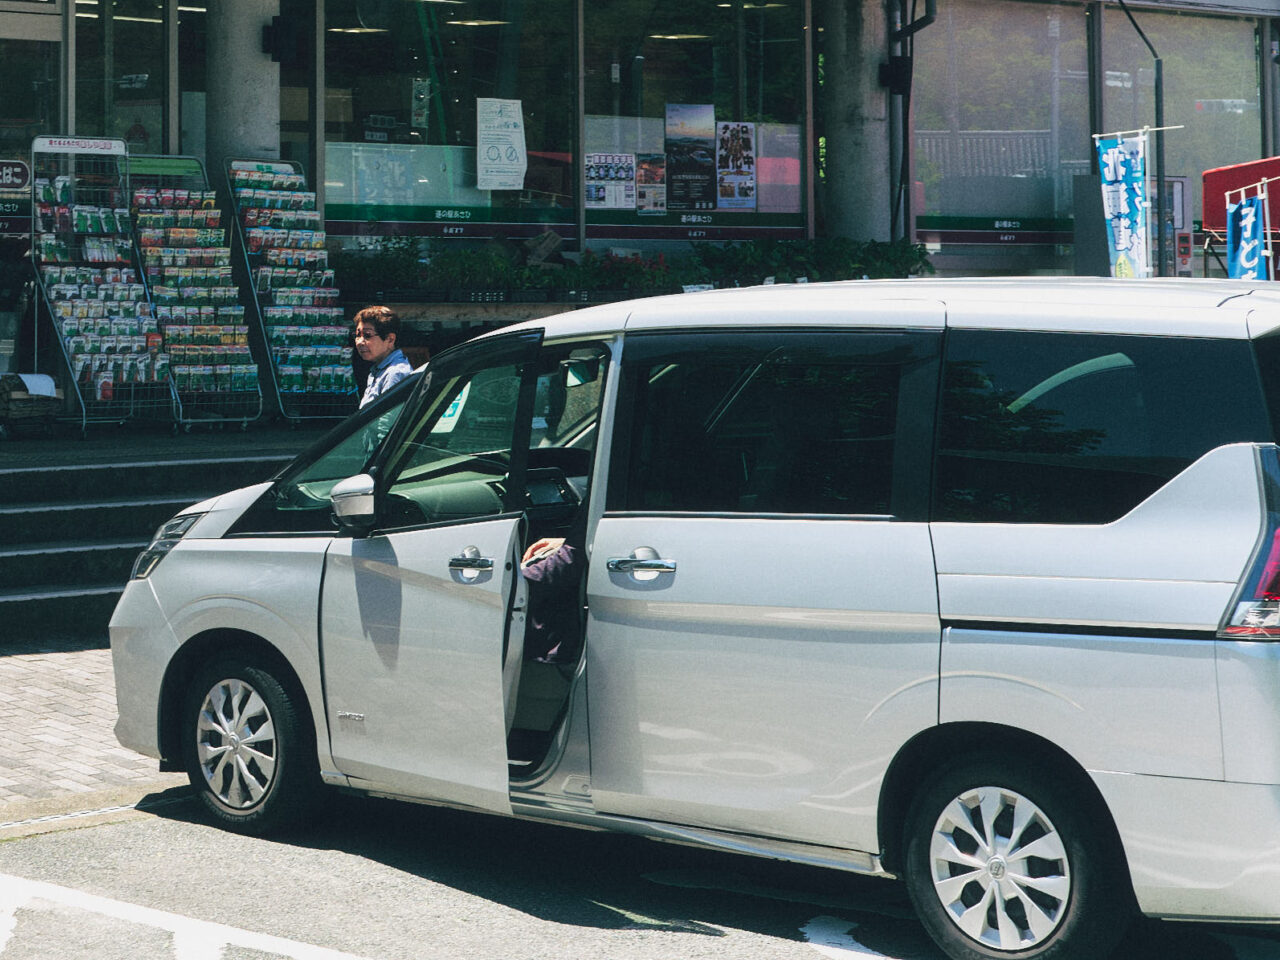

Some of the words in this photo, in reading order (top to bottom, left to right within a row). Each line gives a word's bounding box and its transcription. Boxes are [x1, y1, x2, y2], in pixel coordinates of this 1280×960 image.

[434, 209, 472, 219] 道の駅あさひ
[1239, 207, 1259, 280] 子ど
